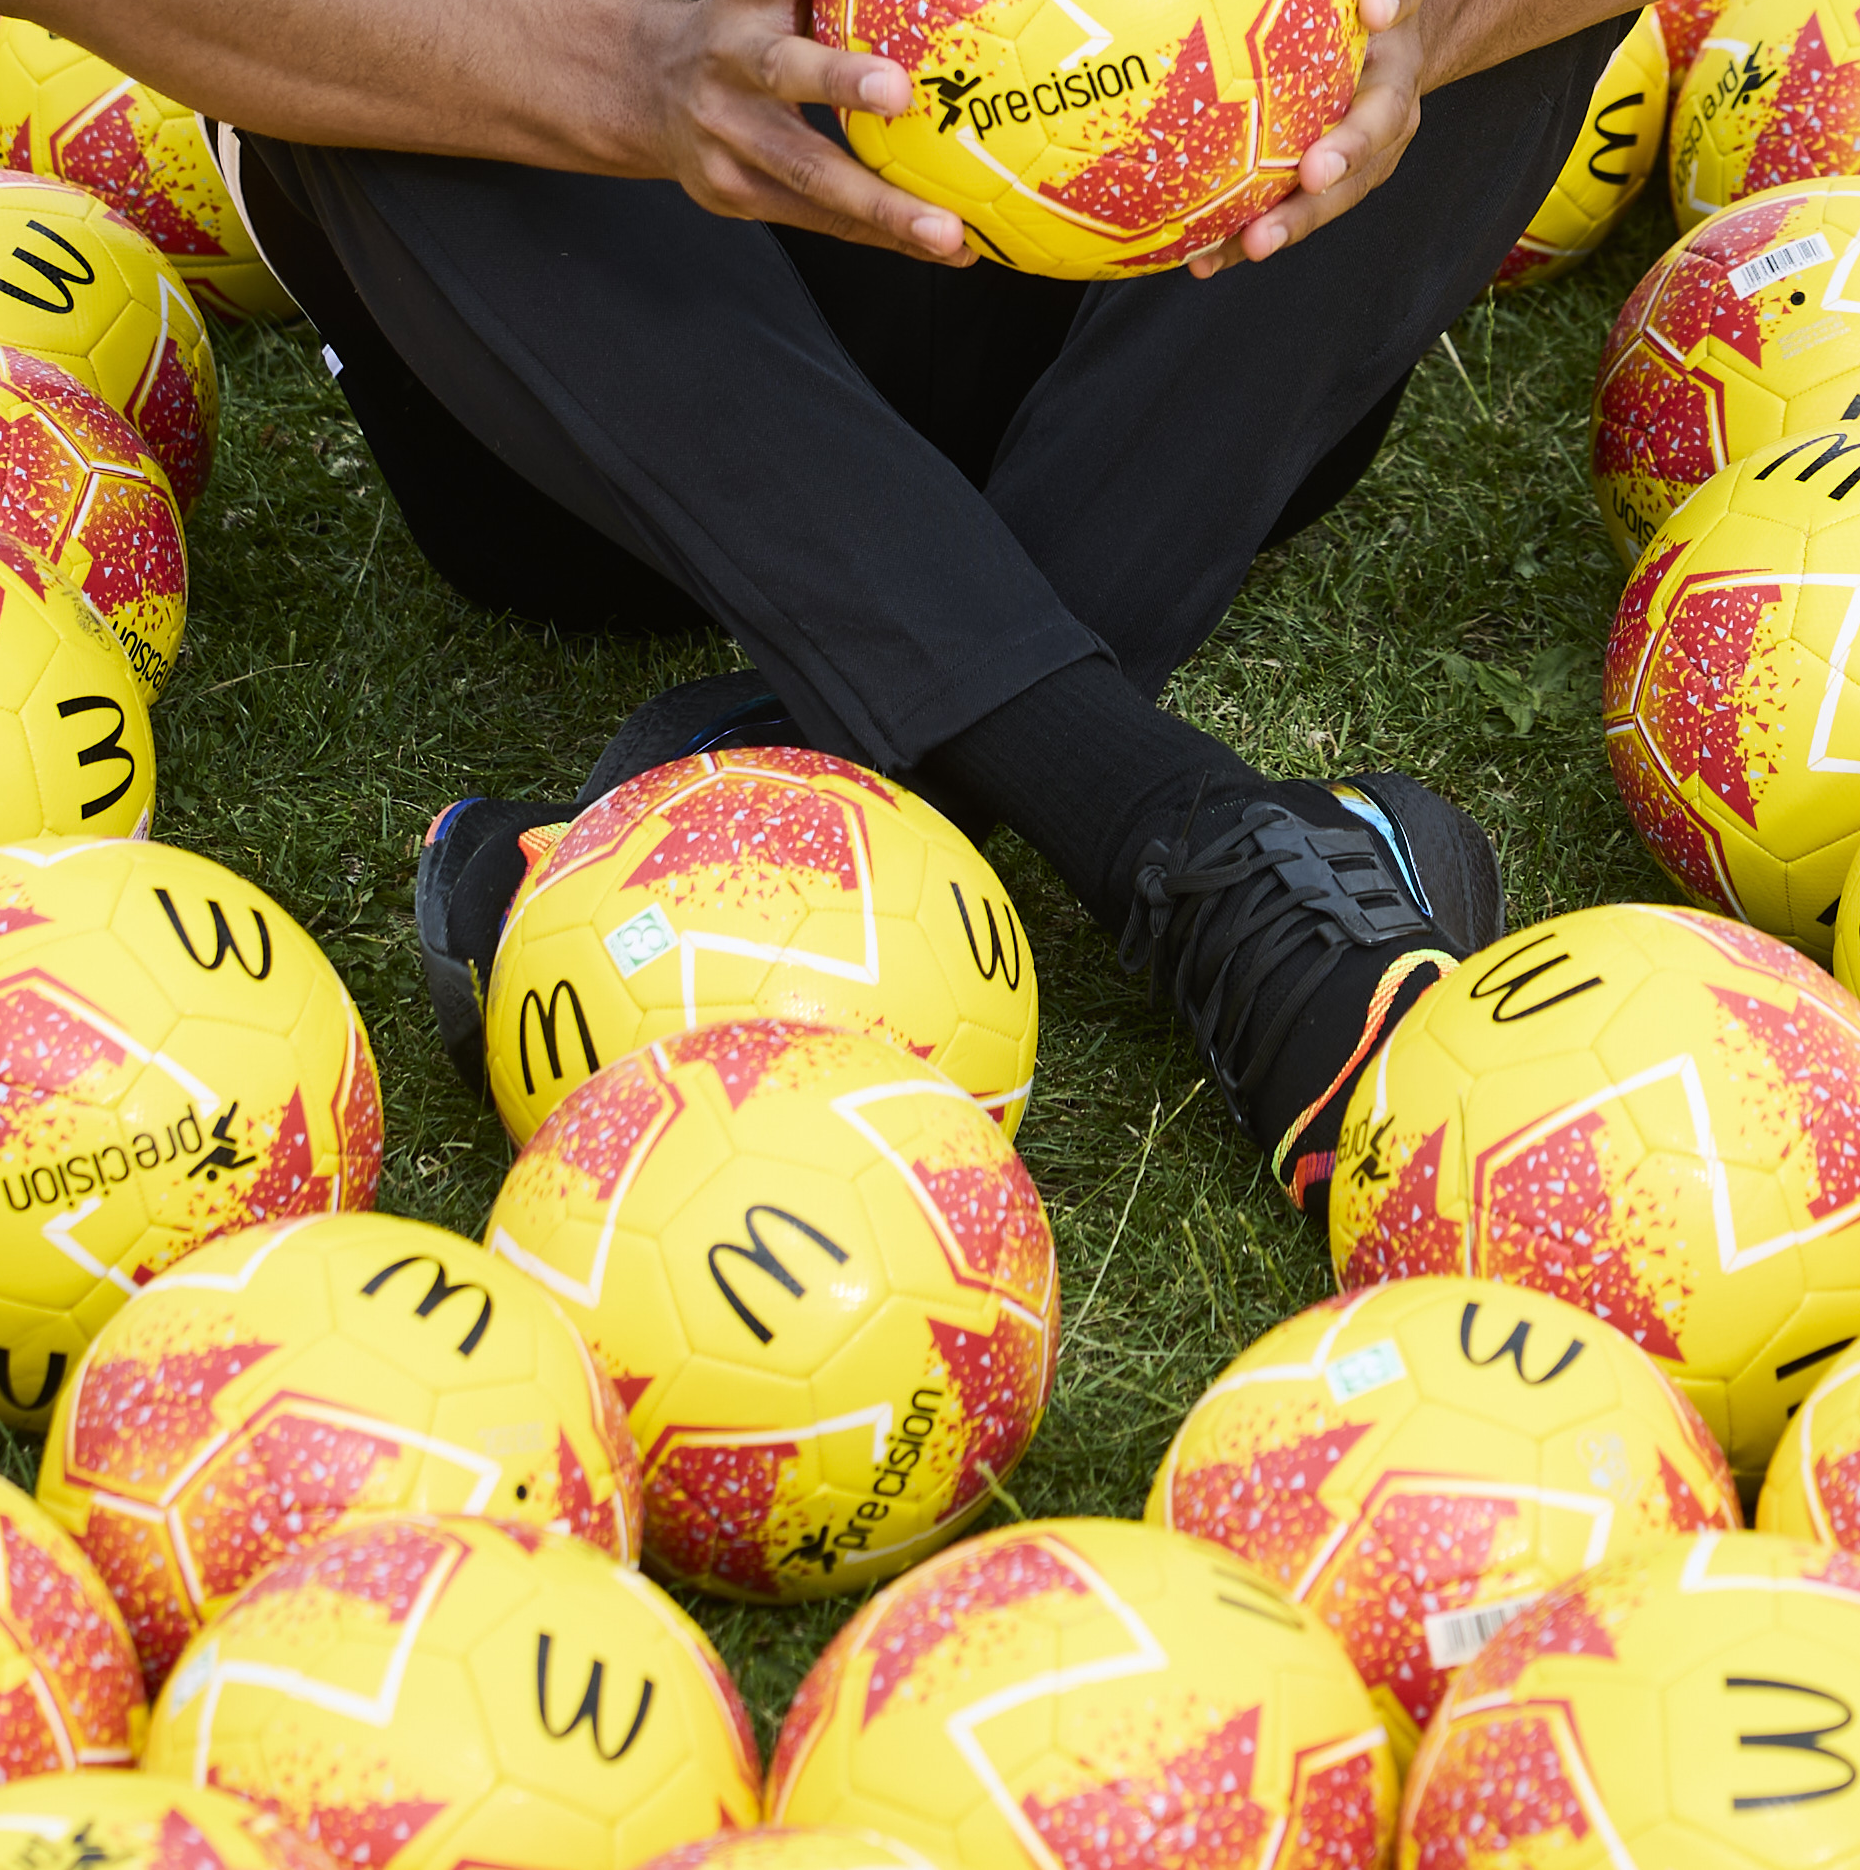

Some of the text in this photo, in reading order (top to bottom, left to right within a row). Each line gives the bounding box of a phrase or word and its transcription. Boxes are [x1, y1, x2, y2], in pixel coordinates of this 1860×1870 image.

[969, 53, 1150, 141] precision
[1589, 90, 1646, 186] M
[1673, 59, 1740, 210] precision
[57, 696, 135, 820] M
[154, 889, 271, 980] M
[951, 882, 1019, 991] M
[1470, 934, 1602, 1022] M
[520, 980, 600, 1096] M
[1, 1113, 205, 1215] precision
[362, 1257, 491, 1356] M
[708, 1206, 847, 1344] M
[1461, 1303, 1583, 1382] M
[833, 1387, 946, 1554] precision
[538, 1634, 653, 1760] M
[1727, 1678, 1855, 1808] M
